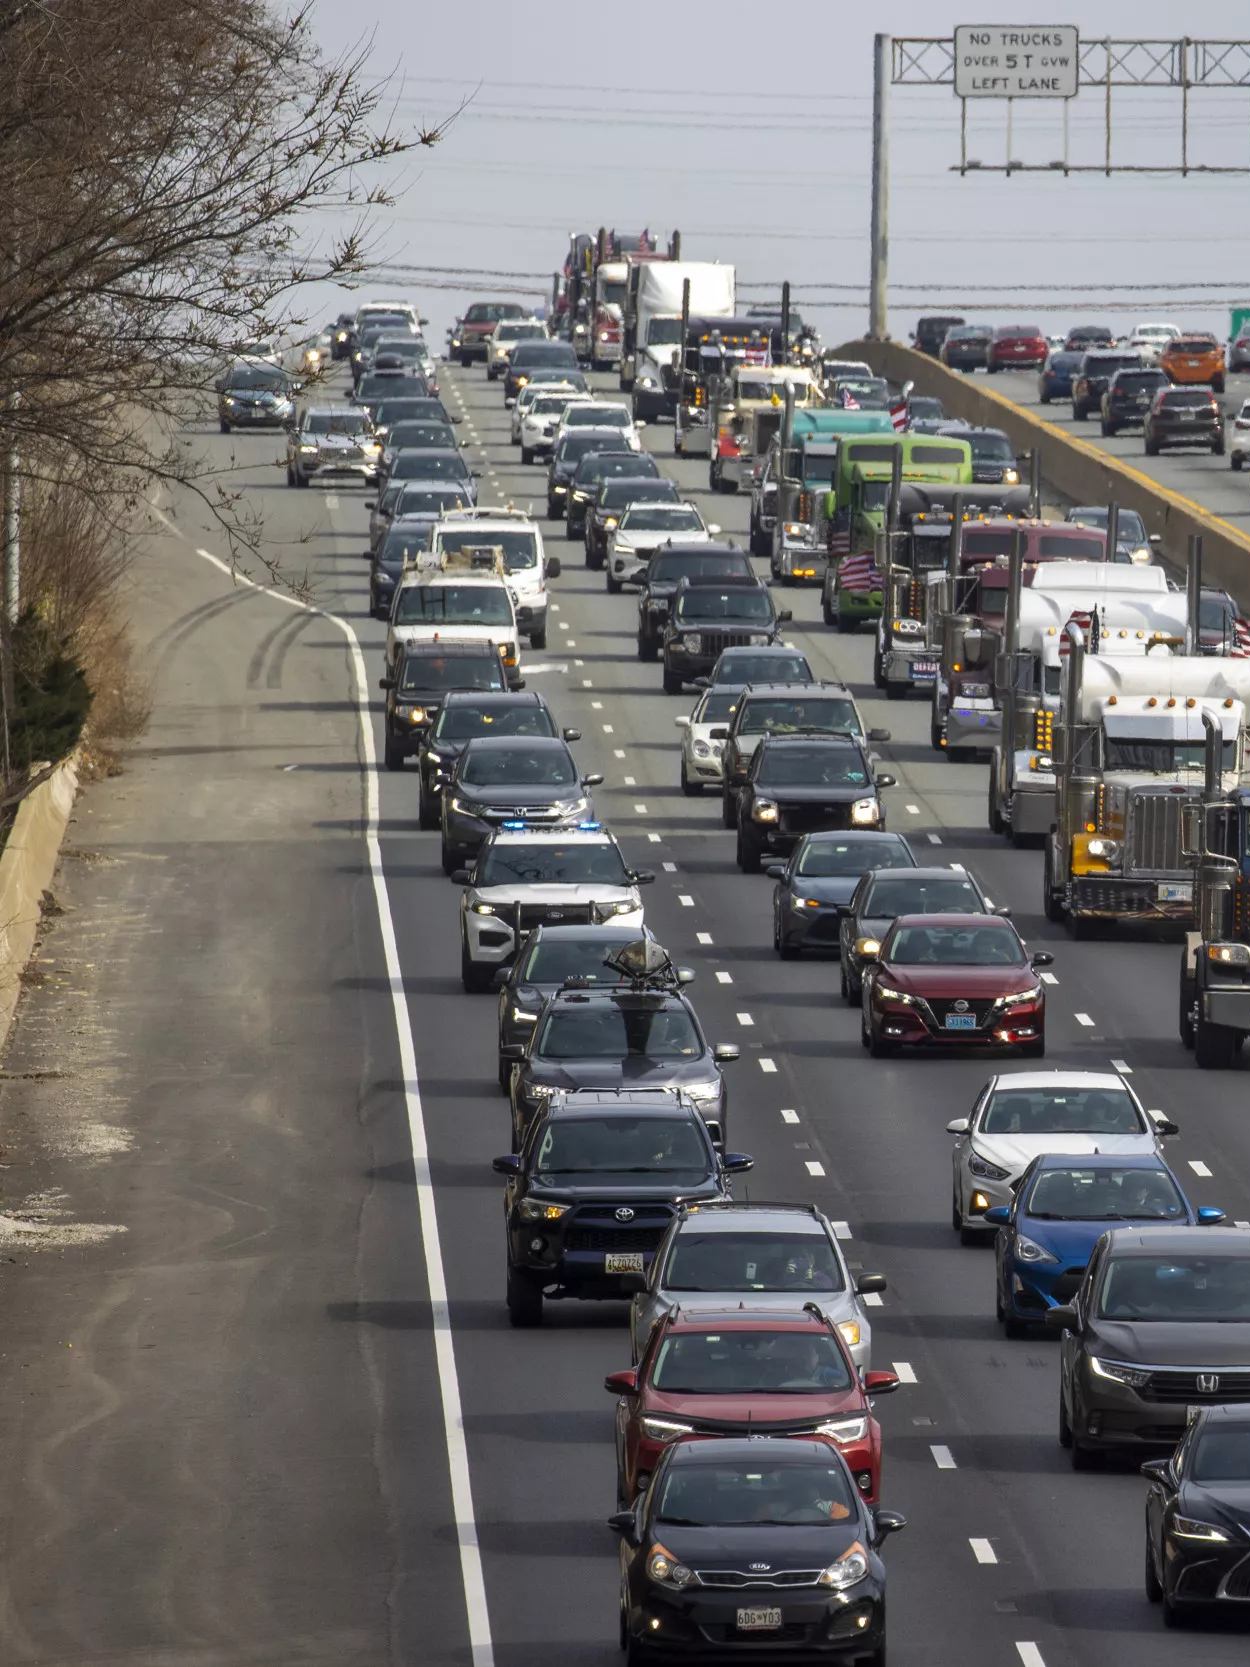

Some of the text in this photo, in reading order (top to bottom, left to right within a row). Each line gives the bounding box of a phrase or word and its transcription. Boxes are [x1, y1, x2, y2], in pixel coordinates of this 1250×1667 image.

[969, 33, 1063, 46] NO TRUCKS
[963, 56, 999, 67] OVER
[1041, 56, 1070, 67] GVW
[972, 78, 1061, 90] LEFT LANE
